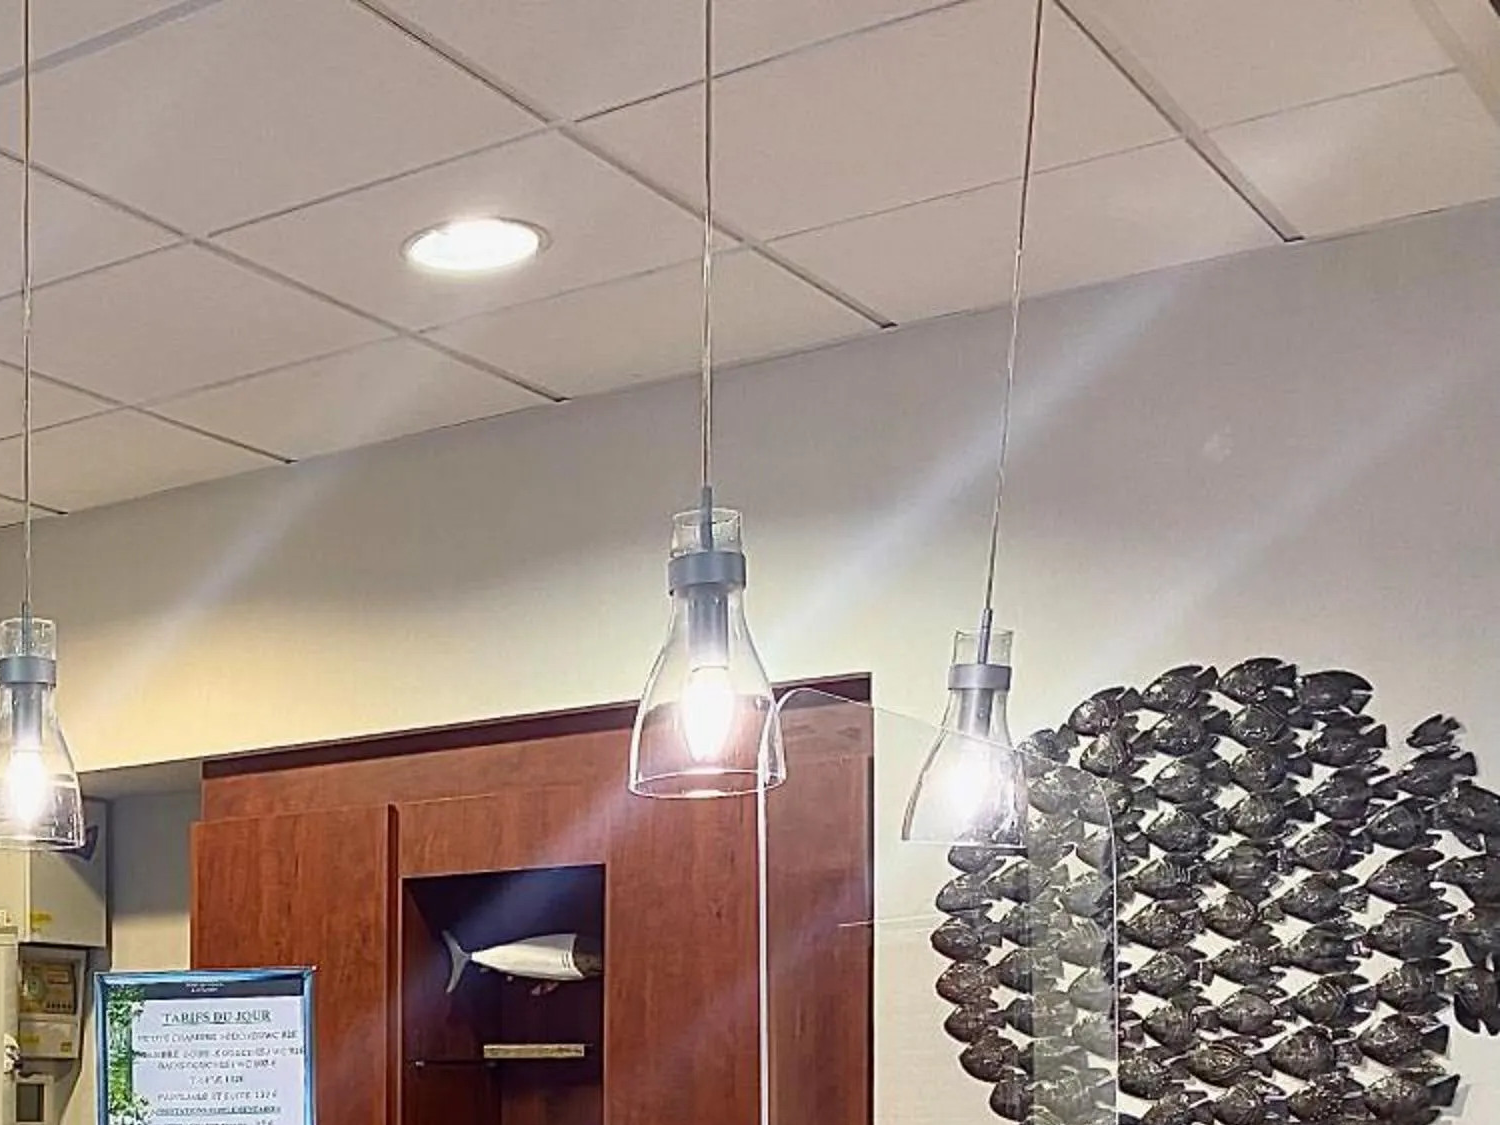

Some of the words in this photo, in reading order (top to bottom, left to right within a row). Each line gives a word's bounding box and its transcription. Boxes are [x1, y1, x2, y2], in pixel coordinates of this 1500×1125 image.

[162, 1011, 210, 1025] TARIFS
[213, 1011, 232, 1022] DU
[235, 1009, 271, 1023] JOUR
